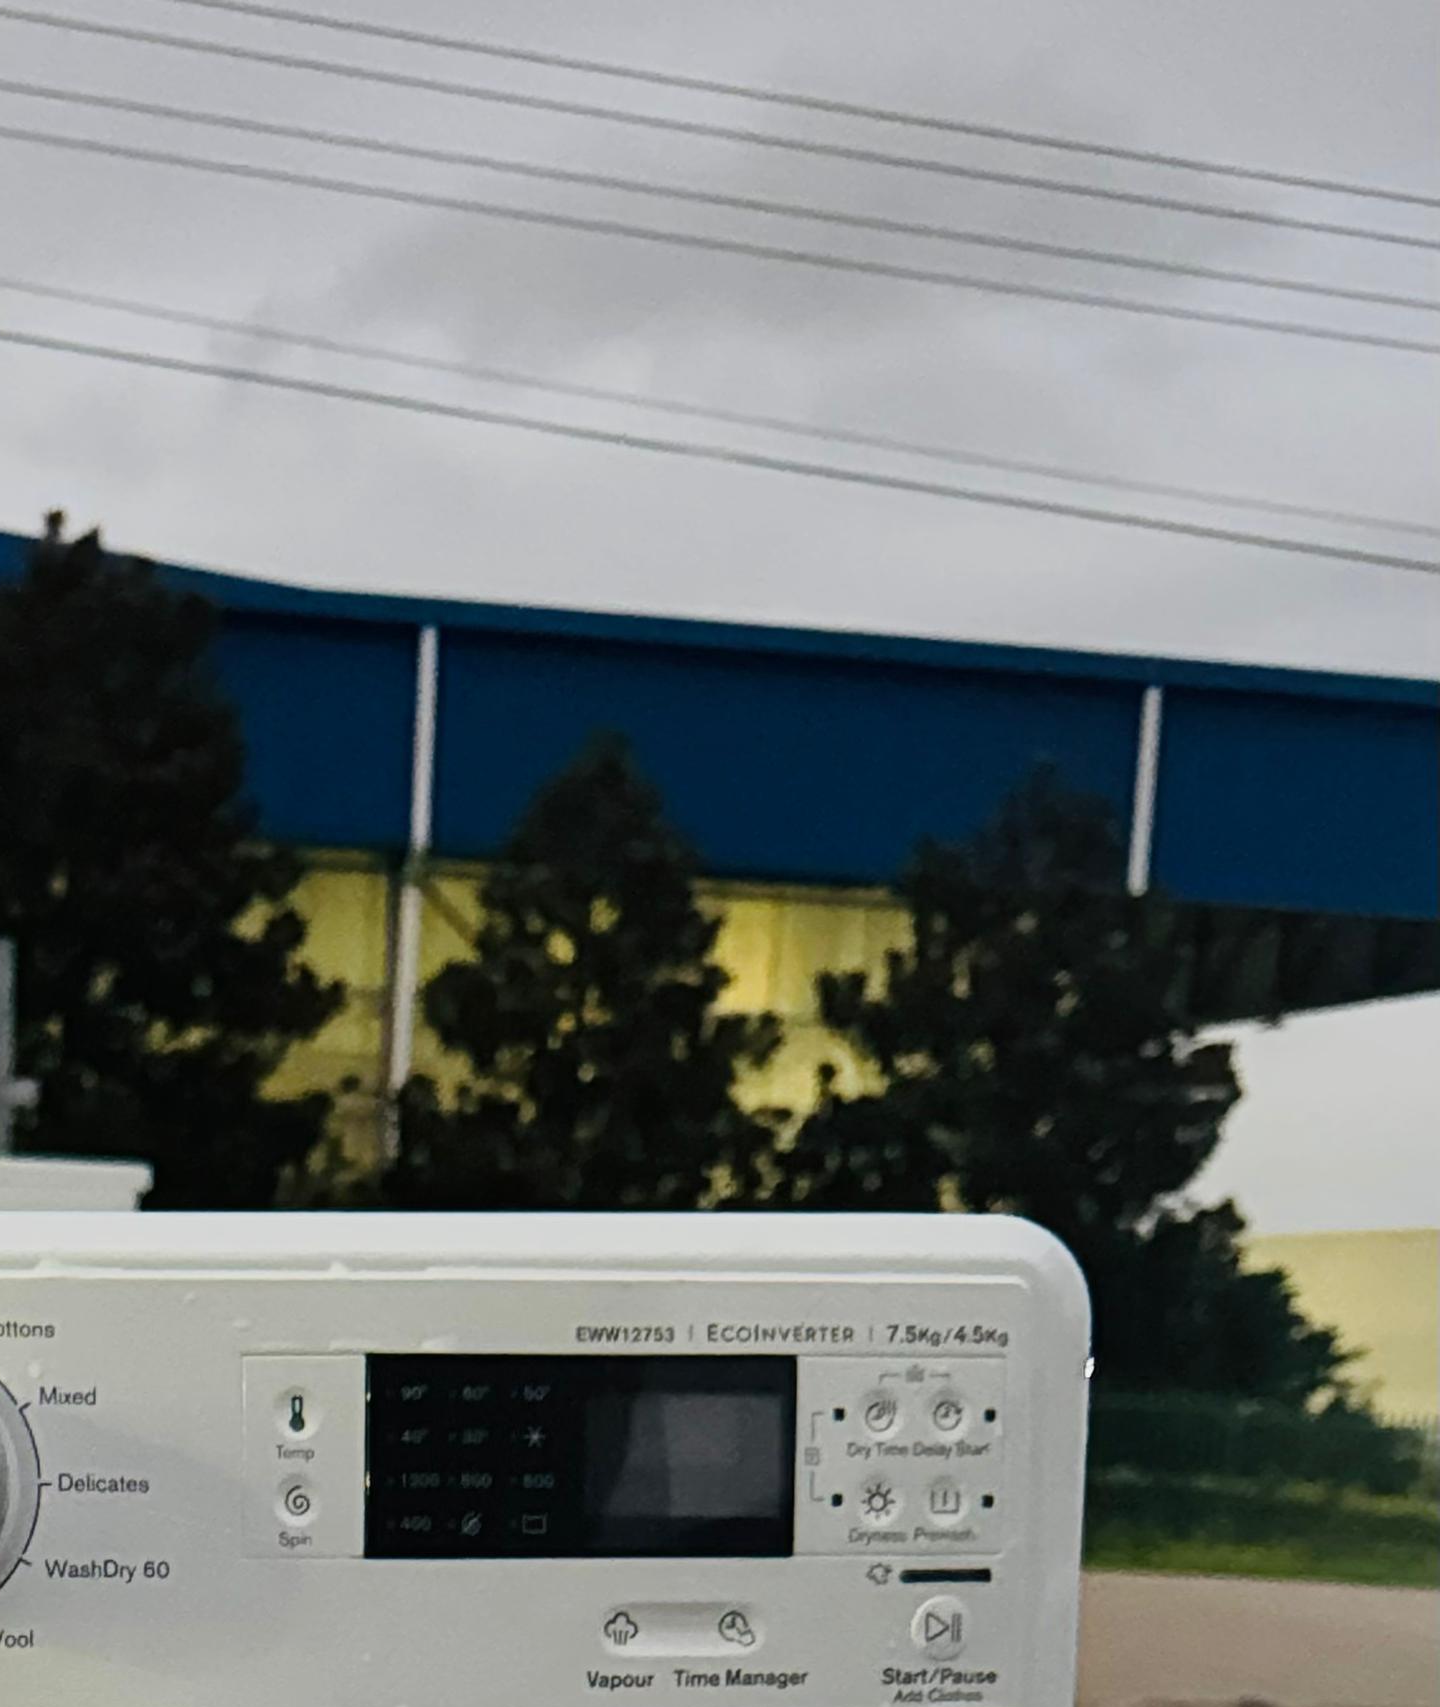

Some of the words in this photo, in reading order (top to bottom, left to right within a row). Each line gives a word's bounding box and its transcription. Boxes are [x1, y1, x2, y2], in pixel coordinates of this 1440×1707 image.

[576, 1326, 675, 1343] EWW12753
[39, 1386, 97, 1406] Mixed
[276, 1446, 315, 1464] Temp
[58, 1474, 150, 1494] Delicates
[278, 1532, 313, 1550] Spin
[45, 1559, 138, 1583] WashDry
[143, 1561, 171, 1580] 60
[586, 1671, 655, 1691] Vapour
[674, 1669, 720, 1686] Time
[725, 1669, 809, 1690] Manager
[881, 1667, 998, 1687] Start/Pause
